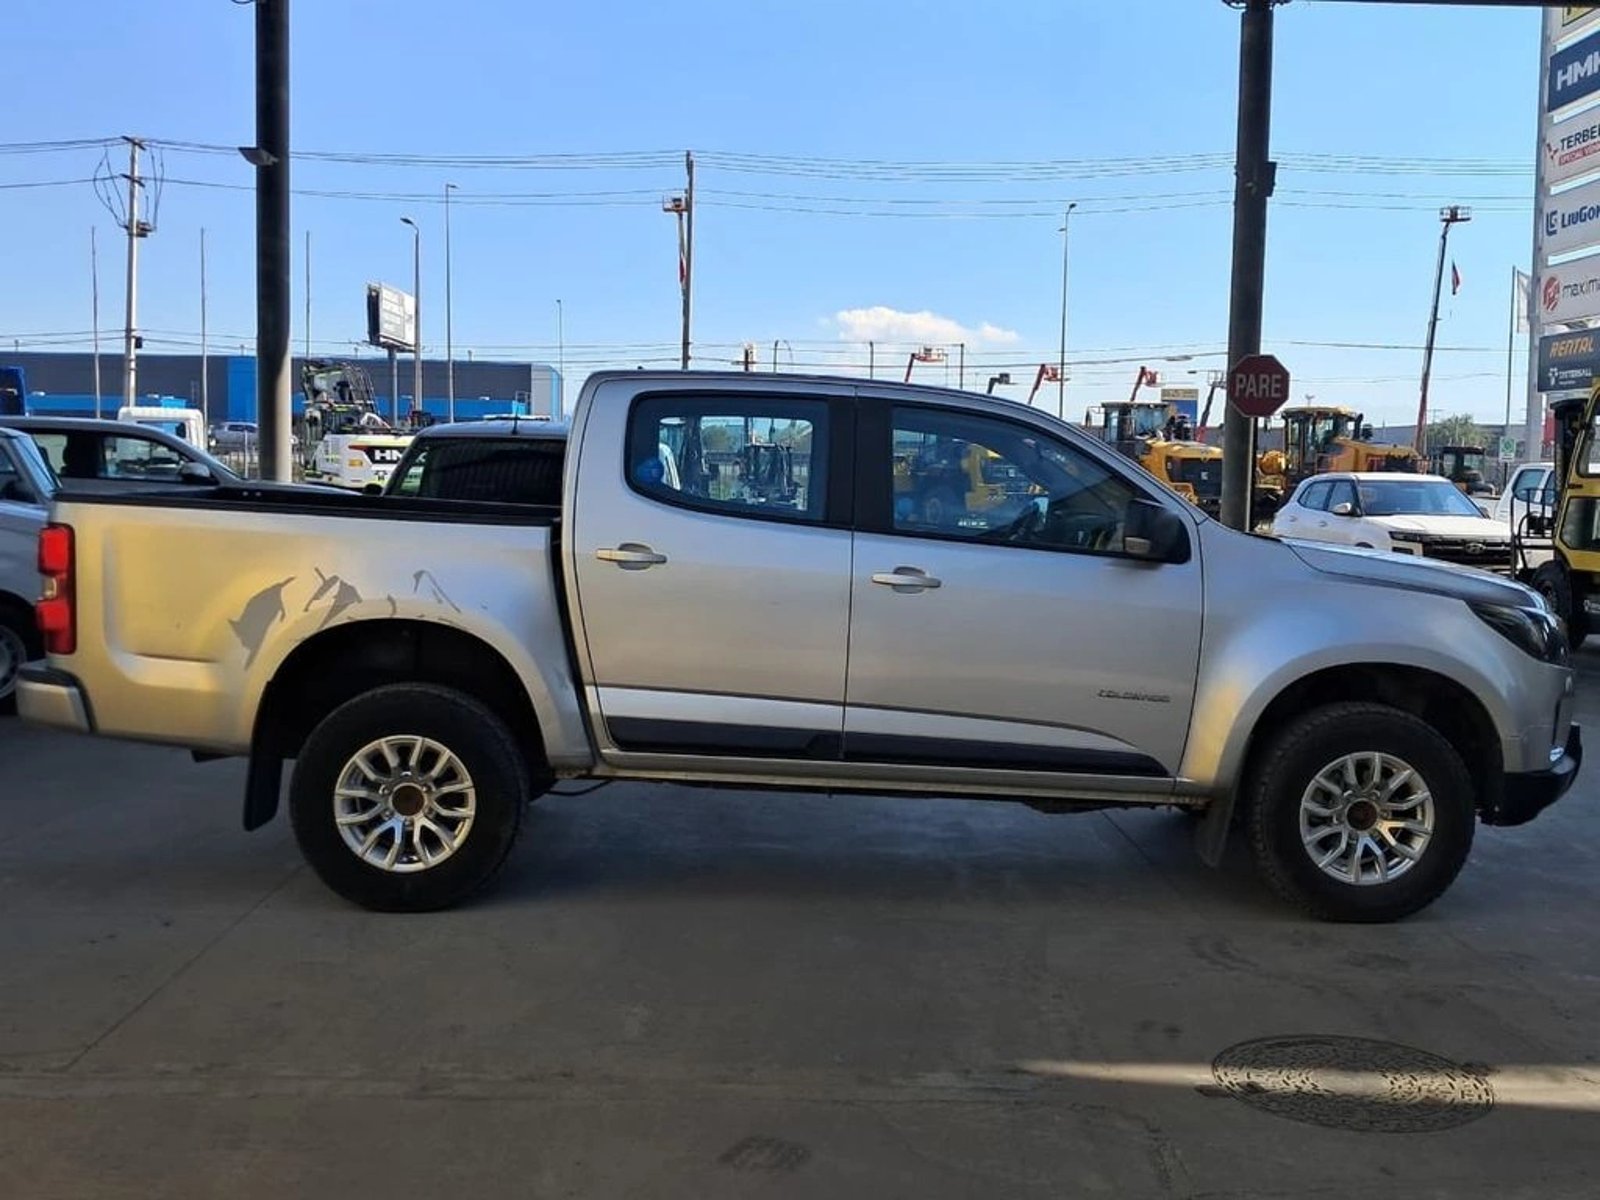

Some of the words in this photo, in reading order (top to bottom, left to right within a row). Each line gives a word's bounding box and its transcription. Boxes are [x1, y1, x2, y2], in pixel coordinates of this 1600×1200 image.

[1556, 51, 1600, 91] HM
[1561, 123, 1600, 151] TERBE
[1235, 373, 1282, 398] PARE
